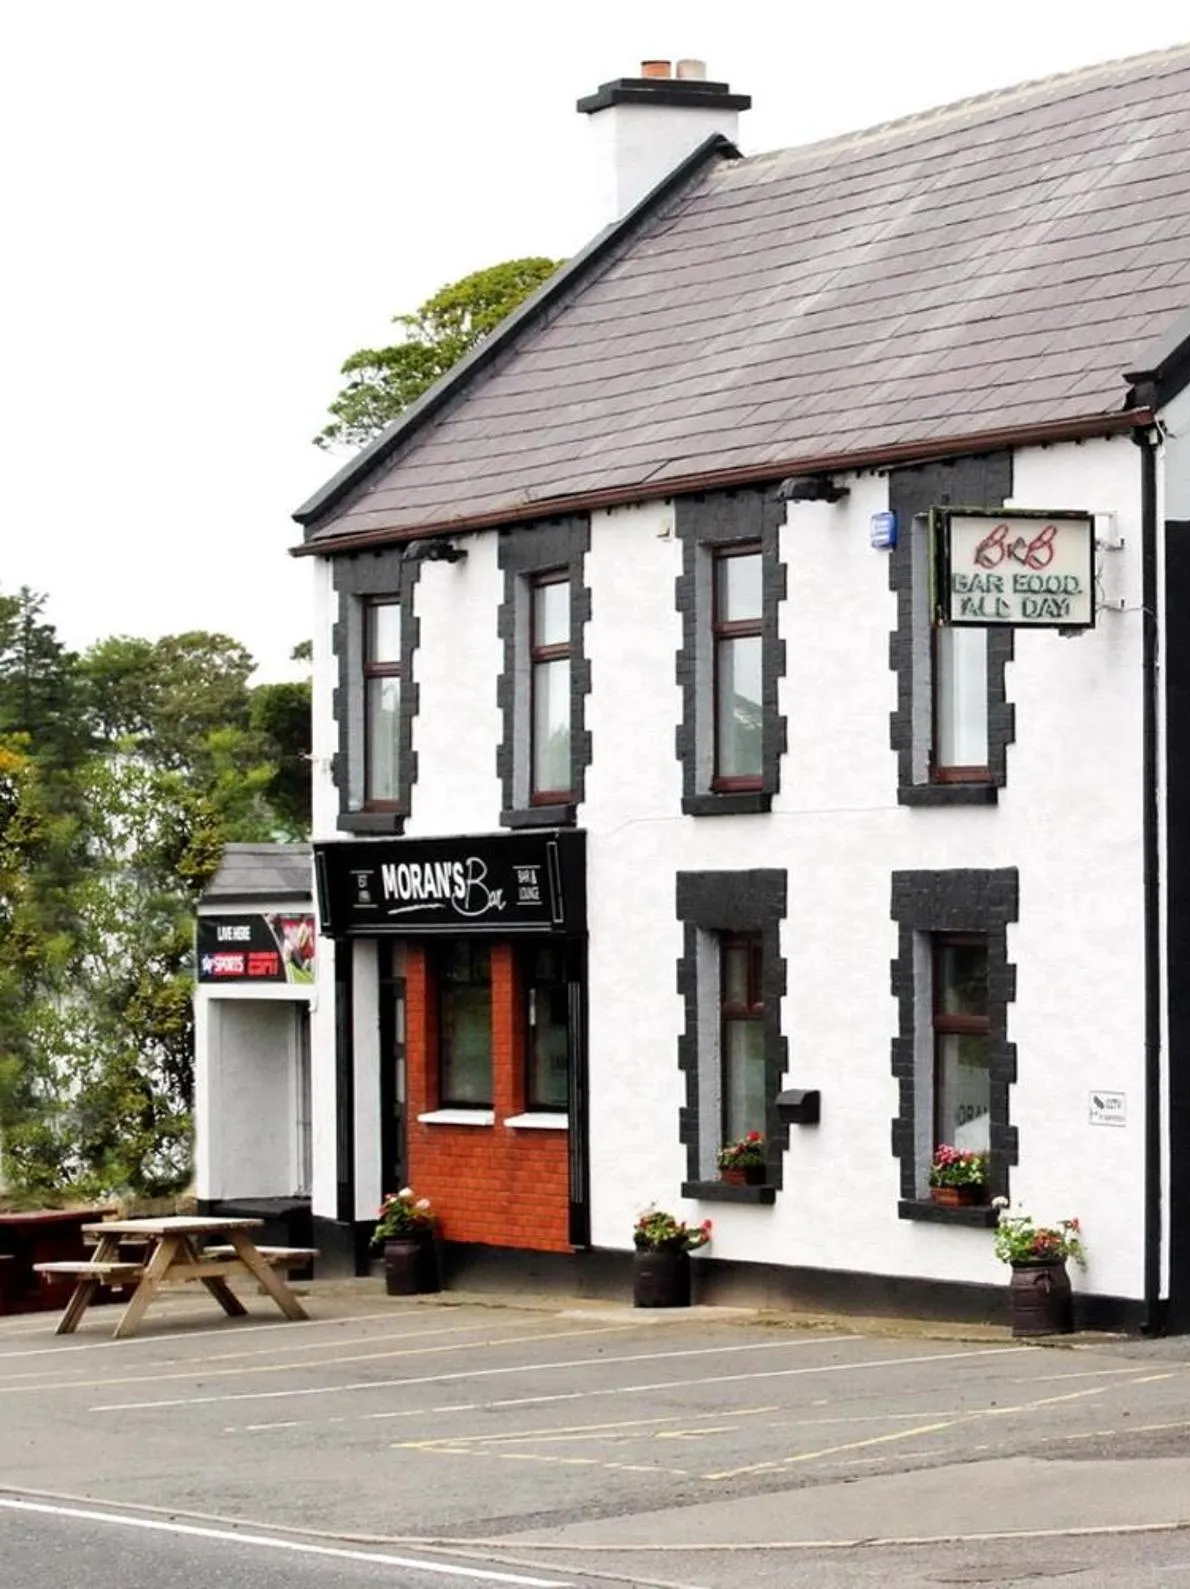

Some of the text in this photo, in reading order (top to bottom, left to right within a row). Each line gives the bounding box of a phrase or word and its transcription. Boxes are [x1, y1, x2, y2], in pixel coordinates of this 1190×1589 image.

[952, 572, 1003, 594] BAR
[381, 857, 507, 917] MORAN'S Bar
